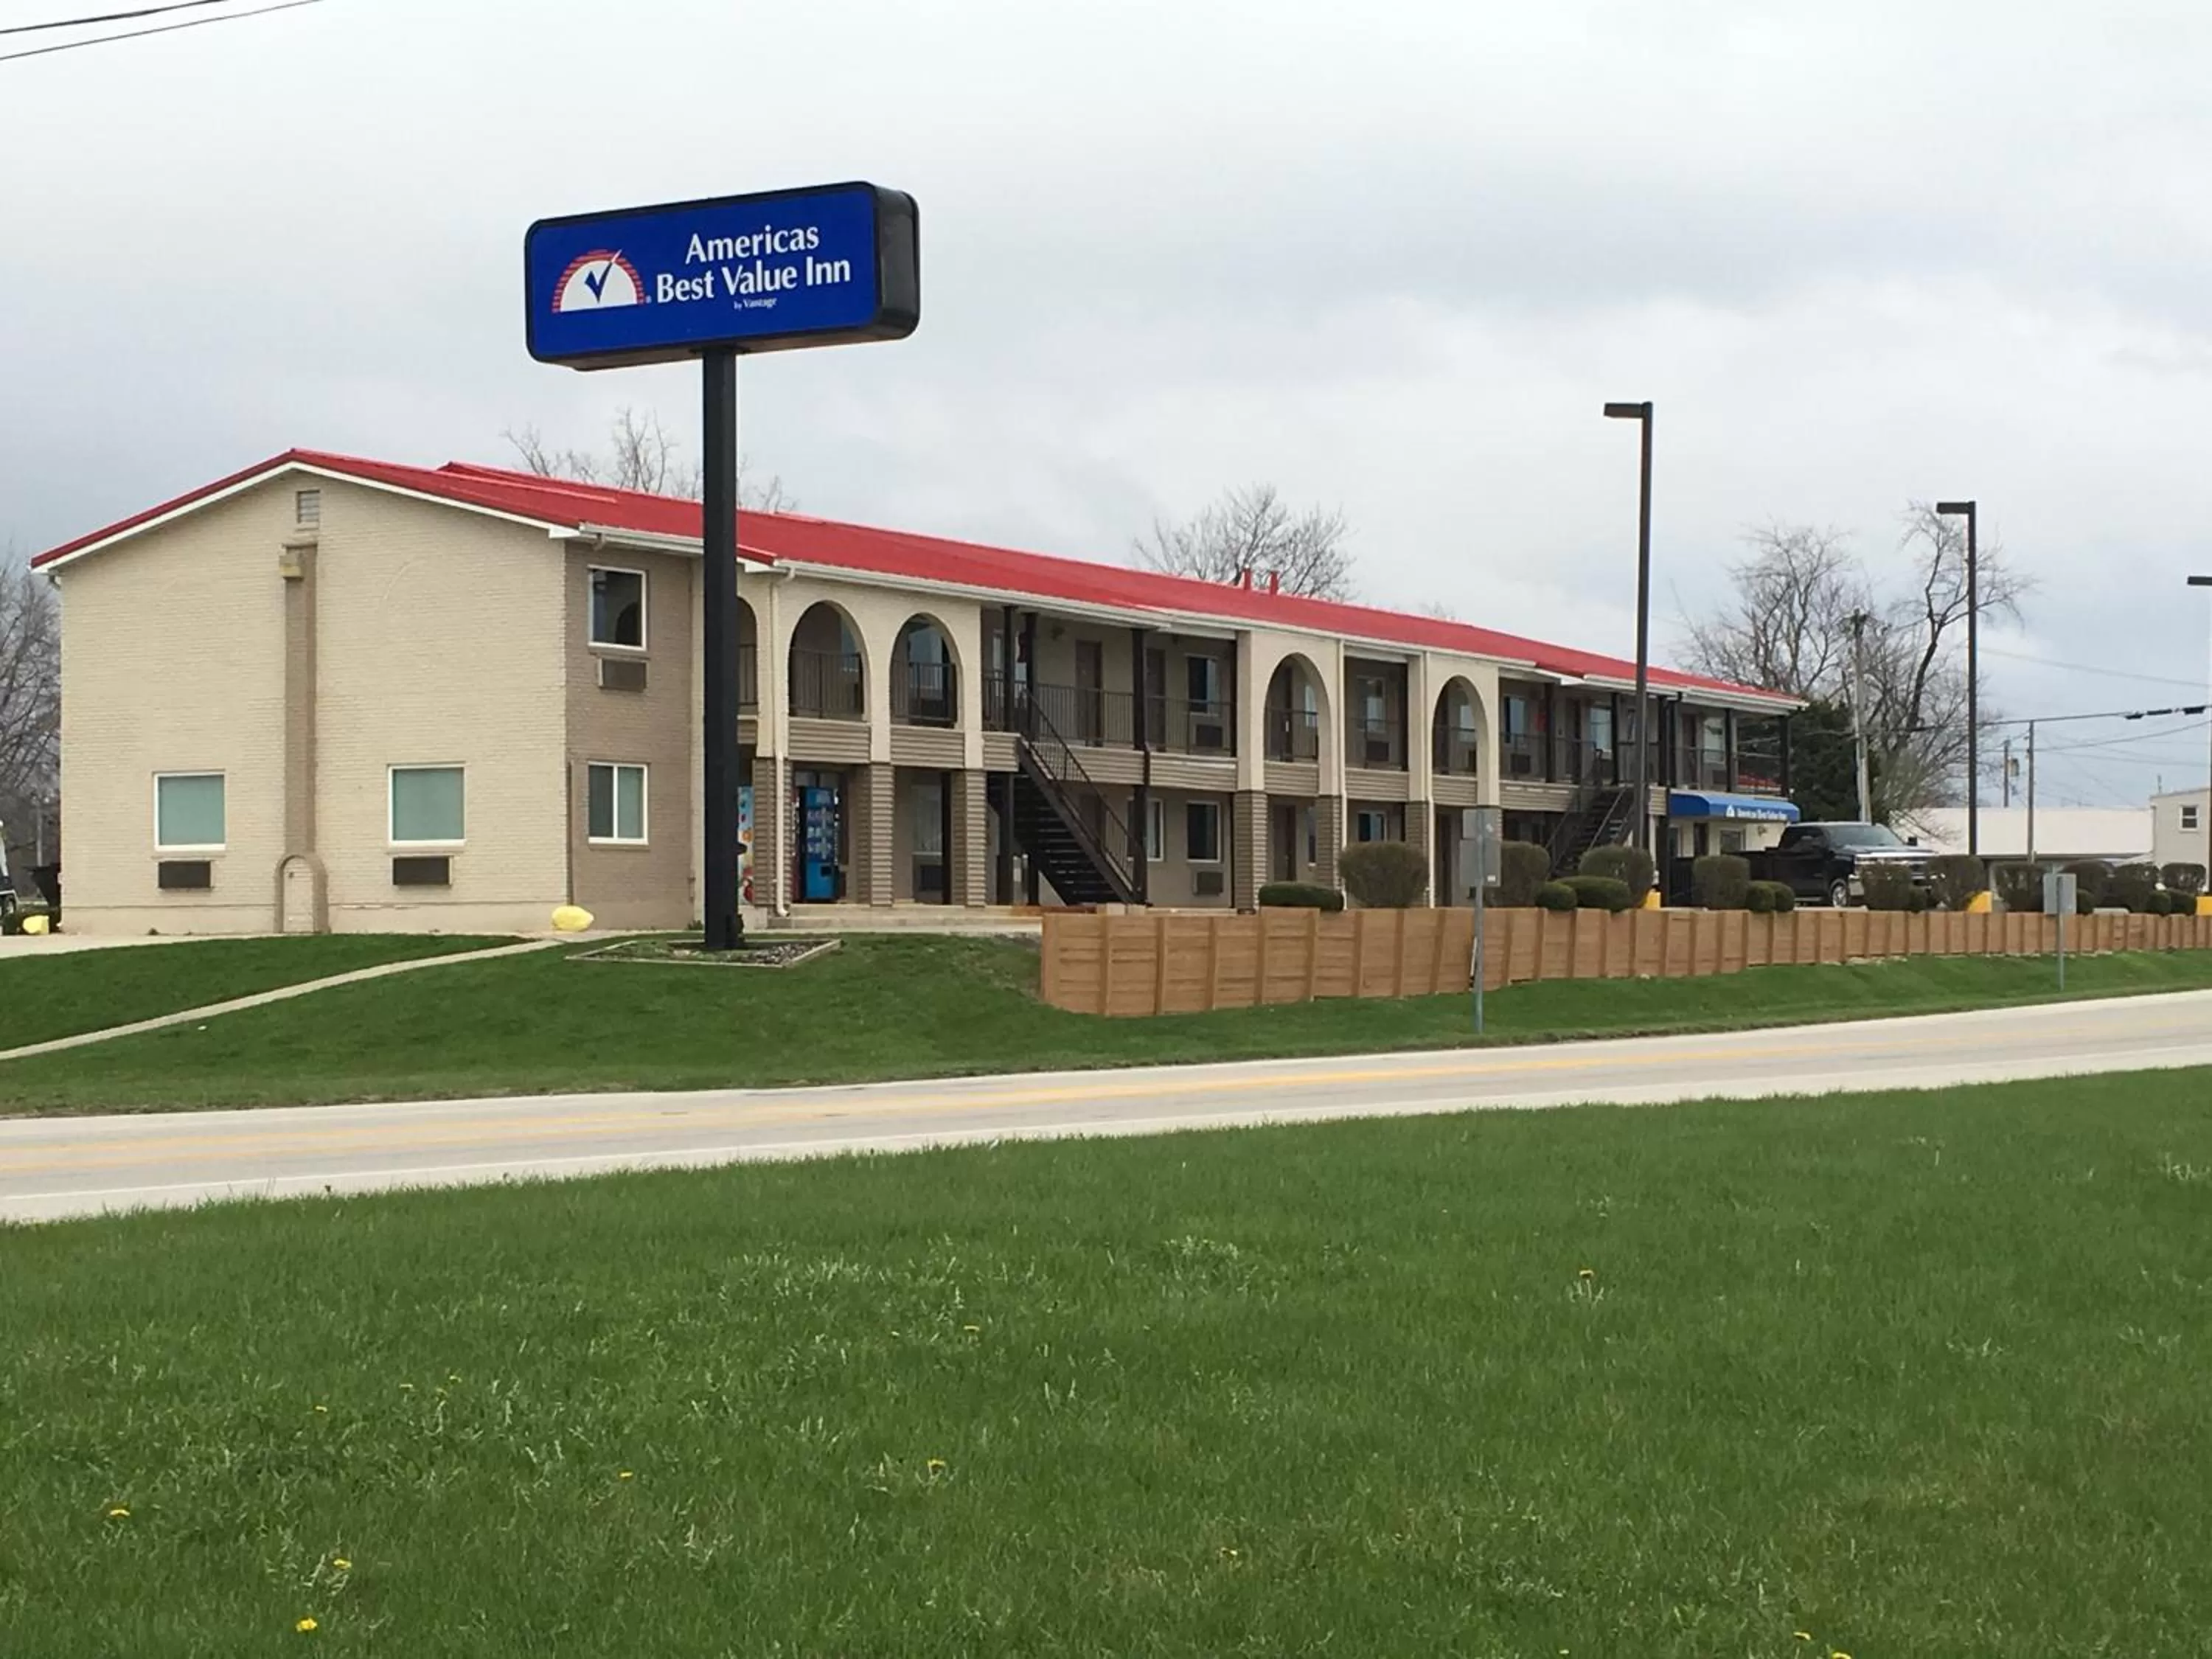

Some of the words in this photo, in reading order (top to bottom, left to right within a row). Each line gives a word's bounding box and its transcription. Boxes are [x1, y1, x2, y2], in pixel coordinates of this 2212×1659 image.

[685, 224, 820, 265] Americas
[656, 271, 714, 304] Best
[721, 260, 798, 296] Value
[806, 256, 851, 286] Inn
